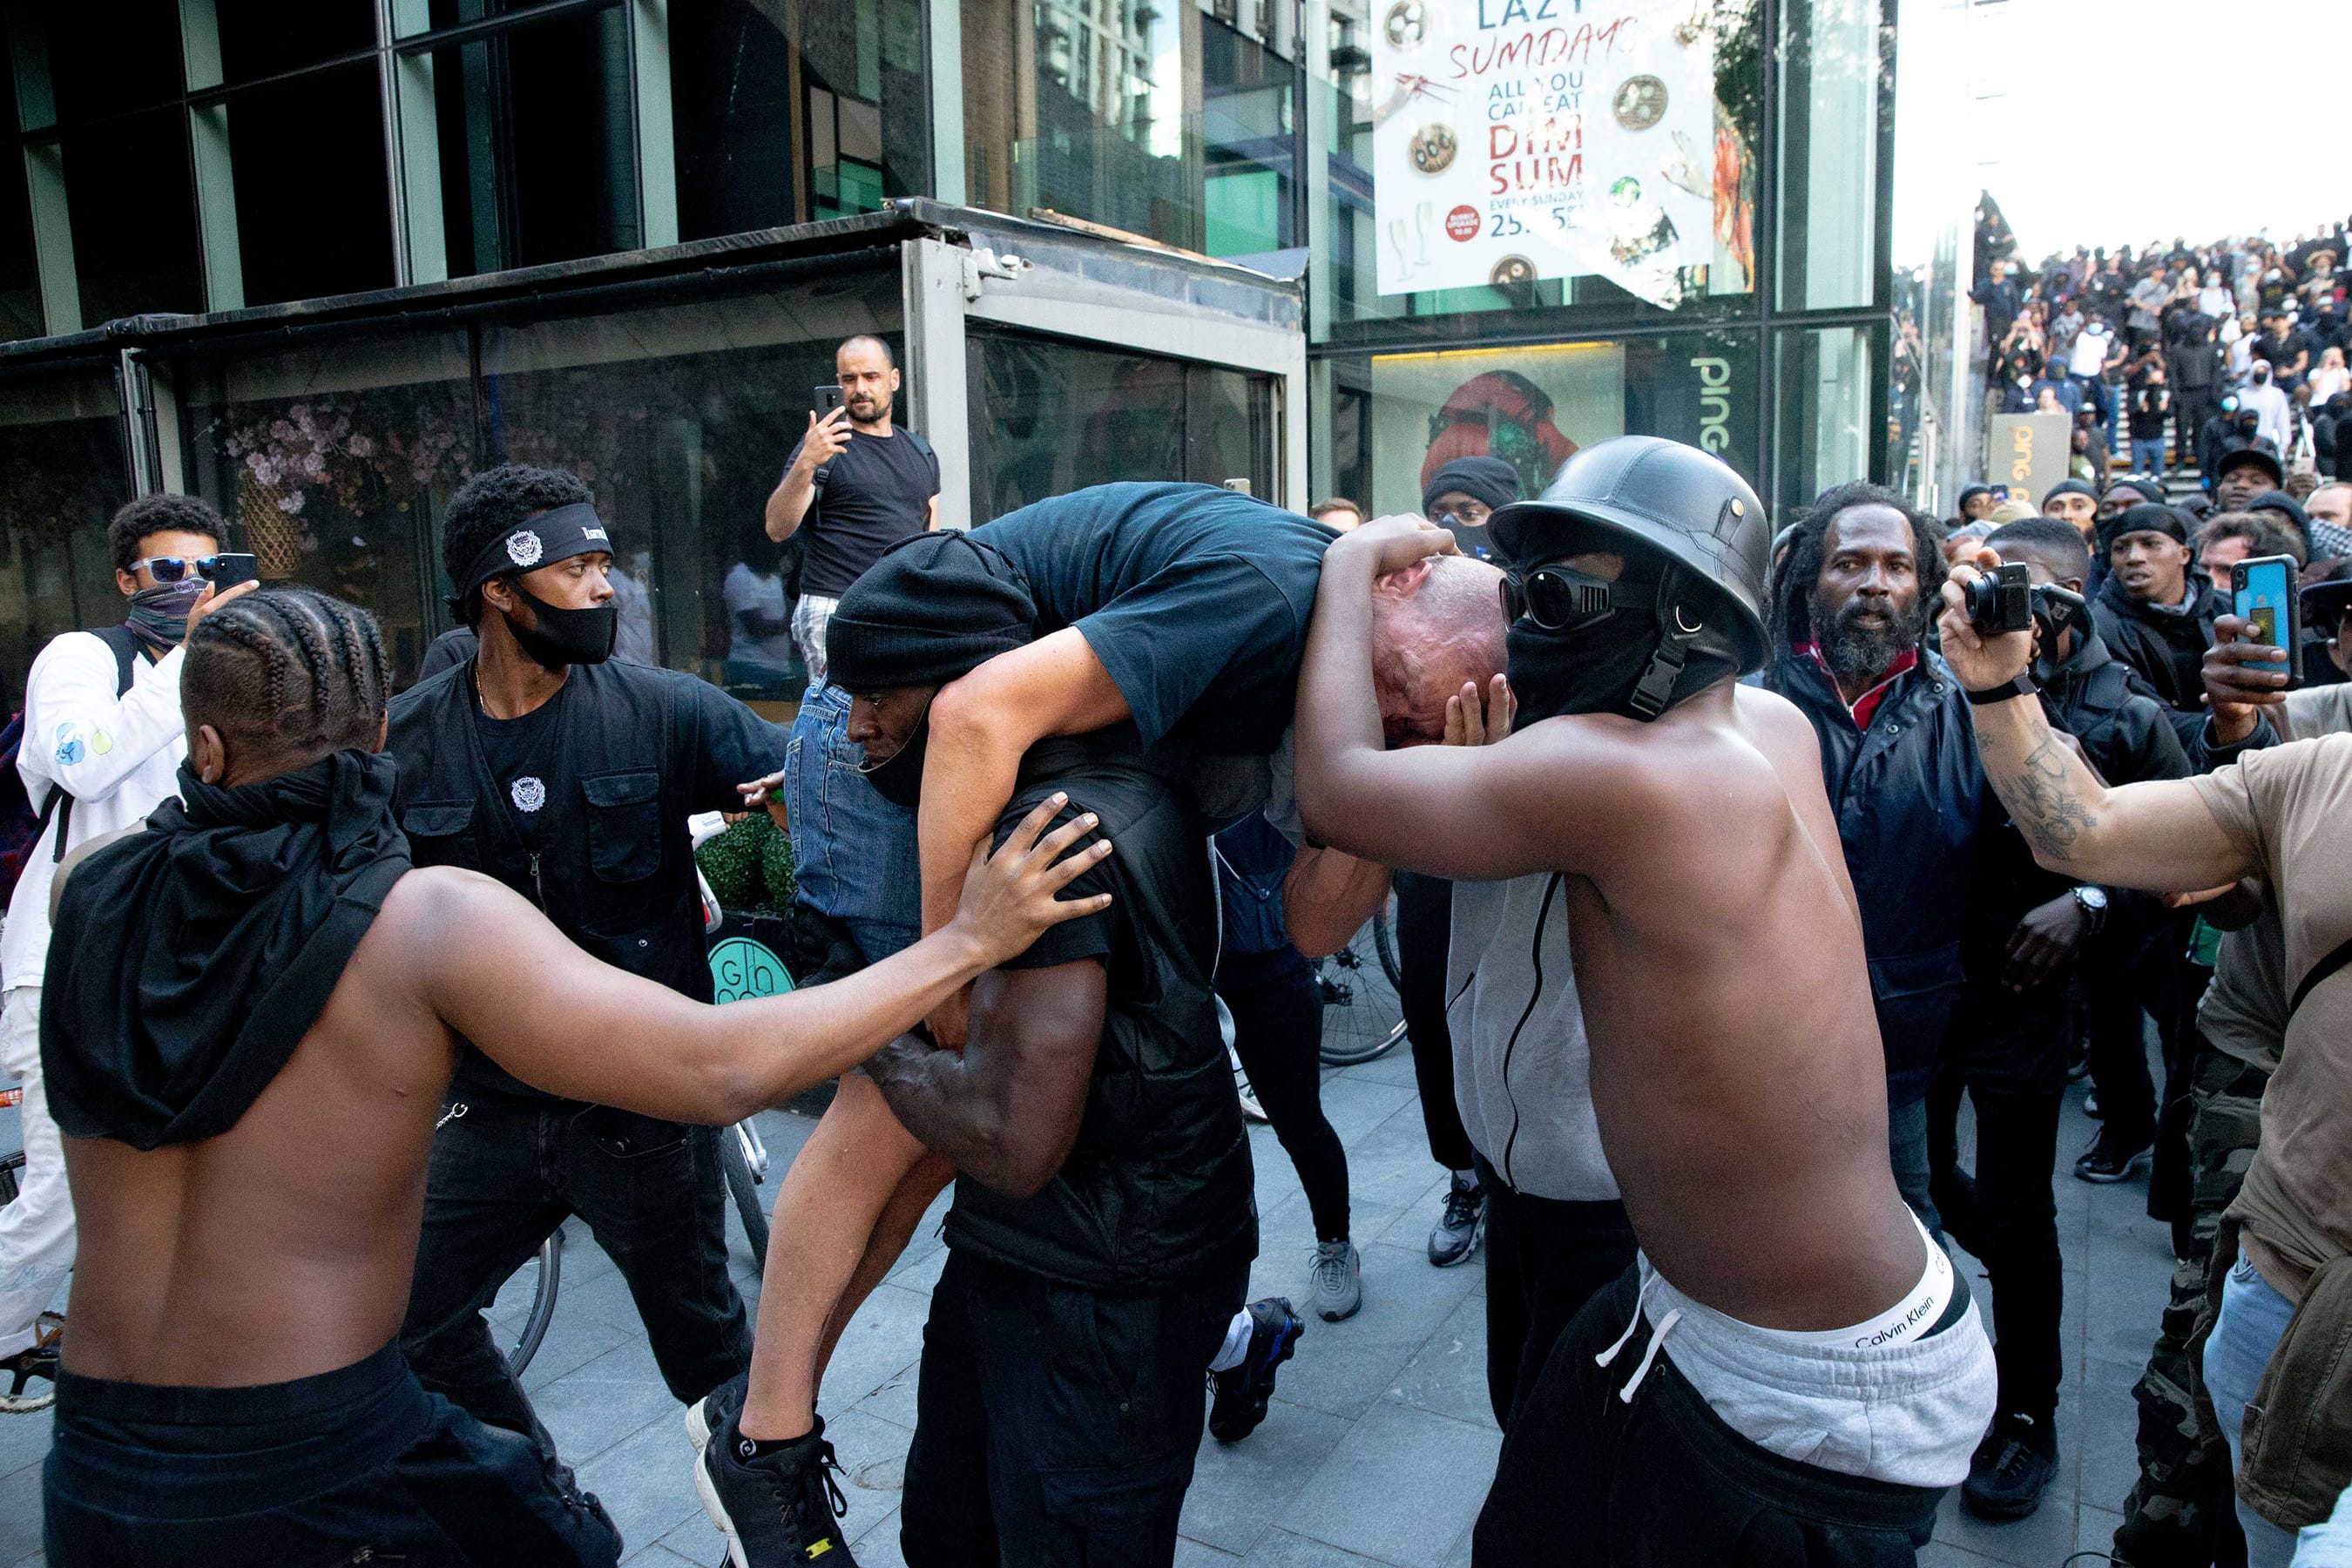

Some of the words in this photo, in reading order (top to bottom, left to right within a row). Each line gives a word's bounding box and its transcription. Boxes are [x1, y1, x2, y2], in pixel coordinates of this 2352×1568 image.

[1489, 78, 1525, 101] ALL
[1490, 114, 1582, 160] DIM
[1490, 153, 1583, 195] SUM
[1855, 1322, 1907, 1349] Calvin
[1906, 1296, 1935, 1327] Klein
